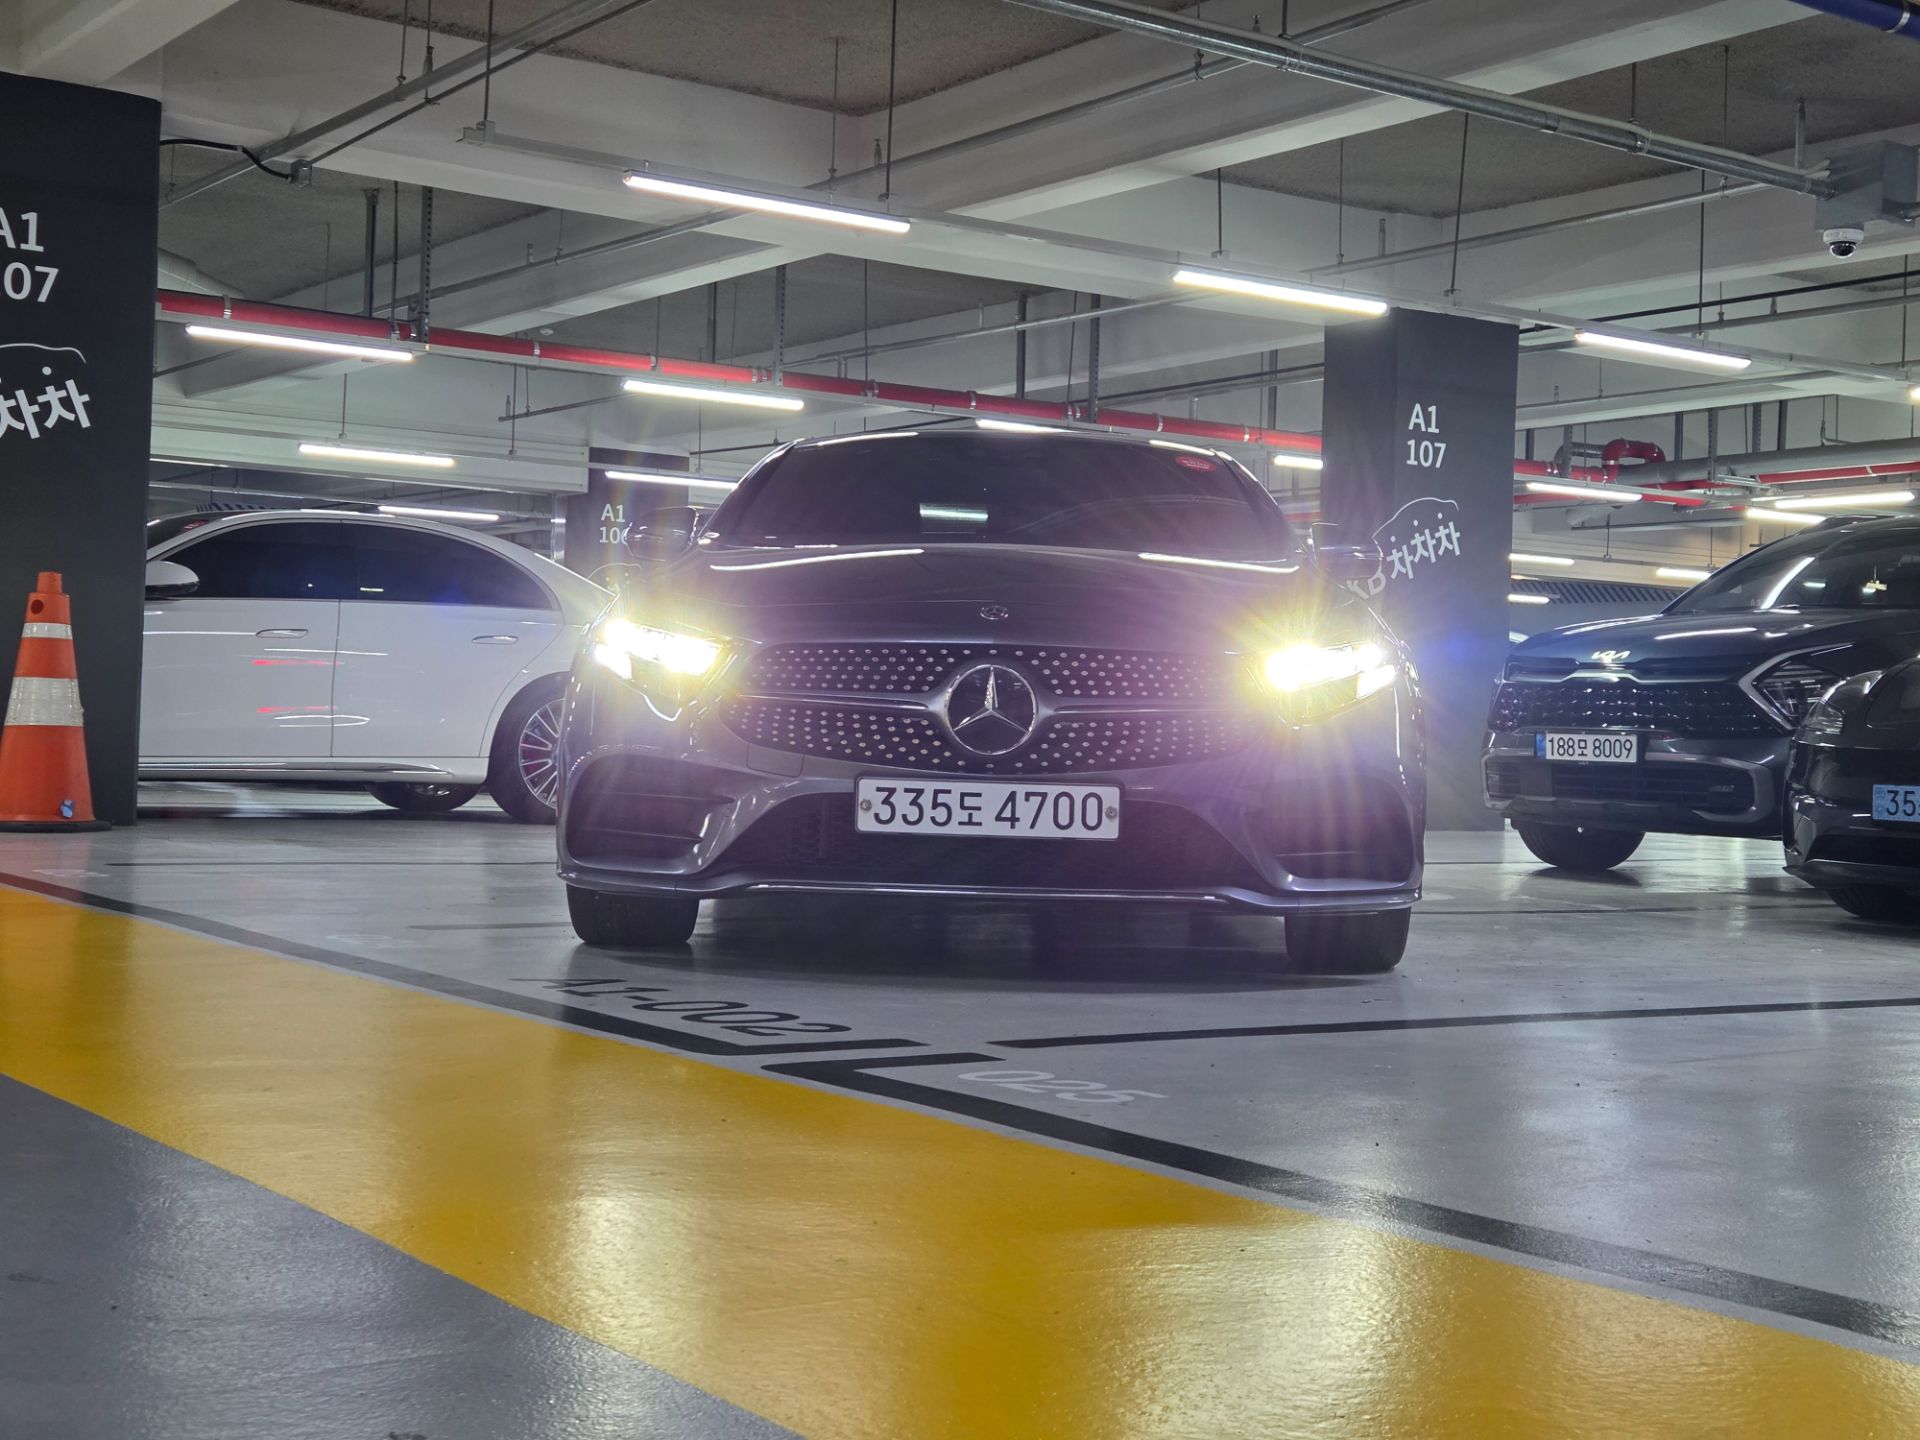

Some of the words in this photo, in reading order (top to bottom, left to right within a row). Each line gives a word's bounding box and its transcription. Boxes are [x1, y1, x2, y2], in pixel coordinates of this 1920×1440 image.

[1408, 402, 1440, 434] A1
[1406, 439, 1447, 468] 107
[600, 503, 625, 523] A1
[1548, 736, 1588, 757] 188모
[1592, 738, 1633, 759] 8009
[873, 786, 983, 827] 335도
[994, 790, 1103, 832] 4700
[1886, 789, 1920, 817] 35
[508, 977, 853, 1037] A1-002
[957, 1070, 1170, 1103] 025
